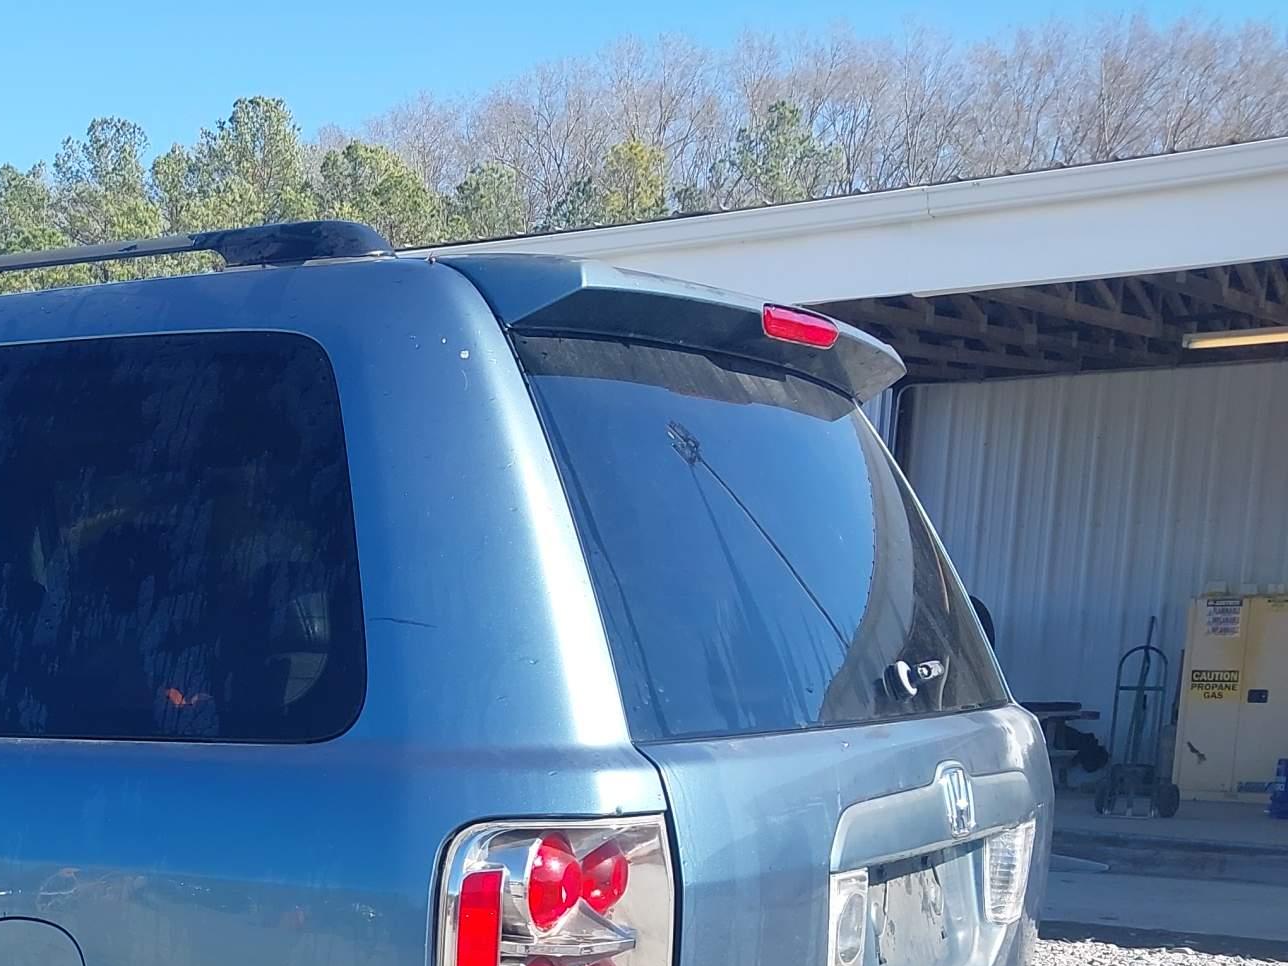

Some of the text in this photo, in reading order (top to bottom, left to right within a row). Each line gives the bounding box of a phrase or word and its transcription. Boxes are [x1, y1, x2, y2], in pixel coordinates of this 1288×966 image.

[1192, 671, 1238, 681] CAUTION
[1190, 683, 1239, 691] PROPANE
[1203, 691, 1224, 699] GAS
